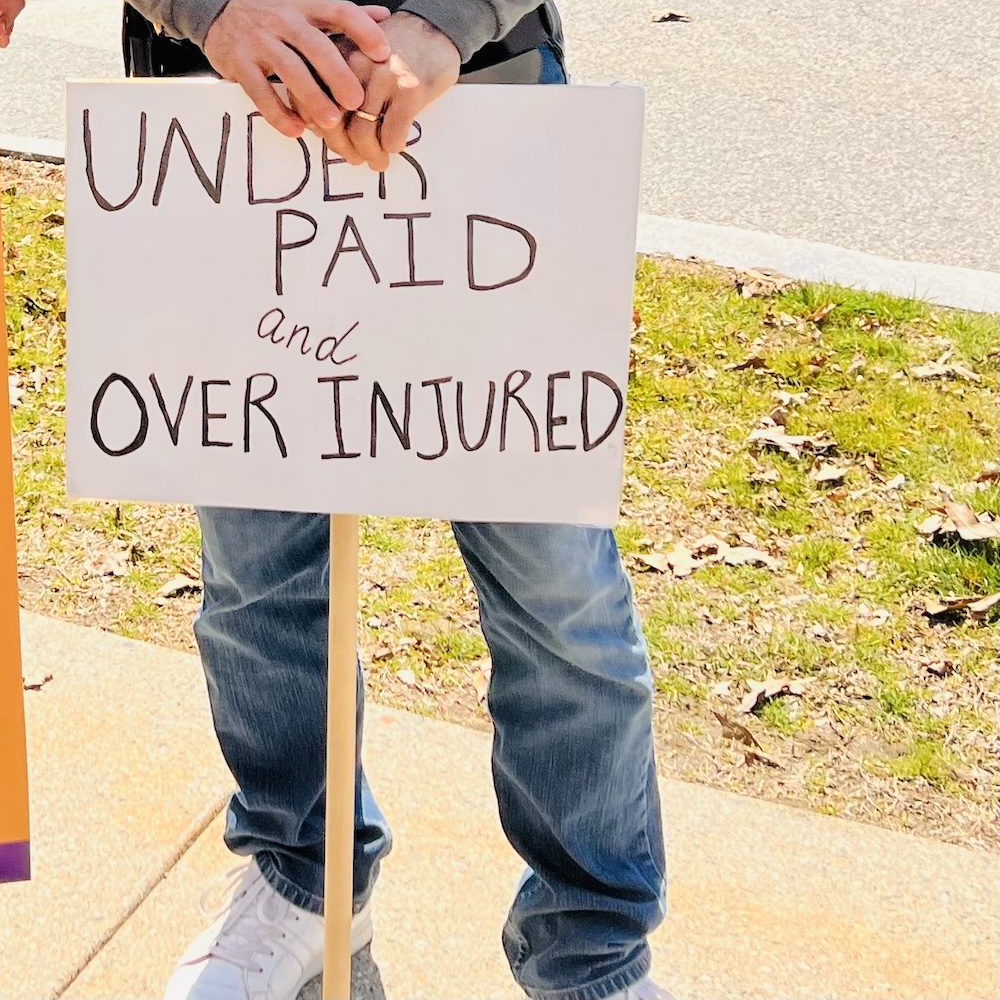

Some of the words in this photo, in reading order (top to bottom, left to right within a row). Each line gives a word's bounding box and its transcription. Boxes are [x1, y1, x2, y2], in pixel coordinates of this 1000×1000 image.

[83, 107, 427, 211] UNDER
[275, 208, 537, 296] PAID
[256, 306, 360, 366] and
[90, 371, 288, 457] OVER
[317, 369, 624, 460] INJURED
